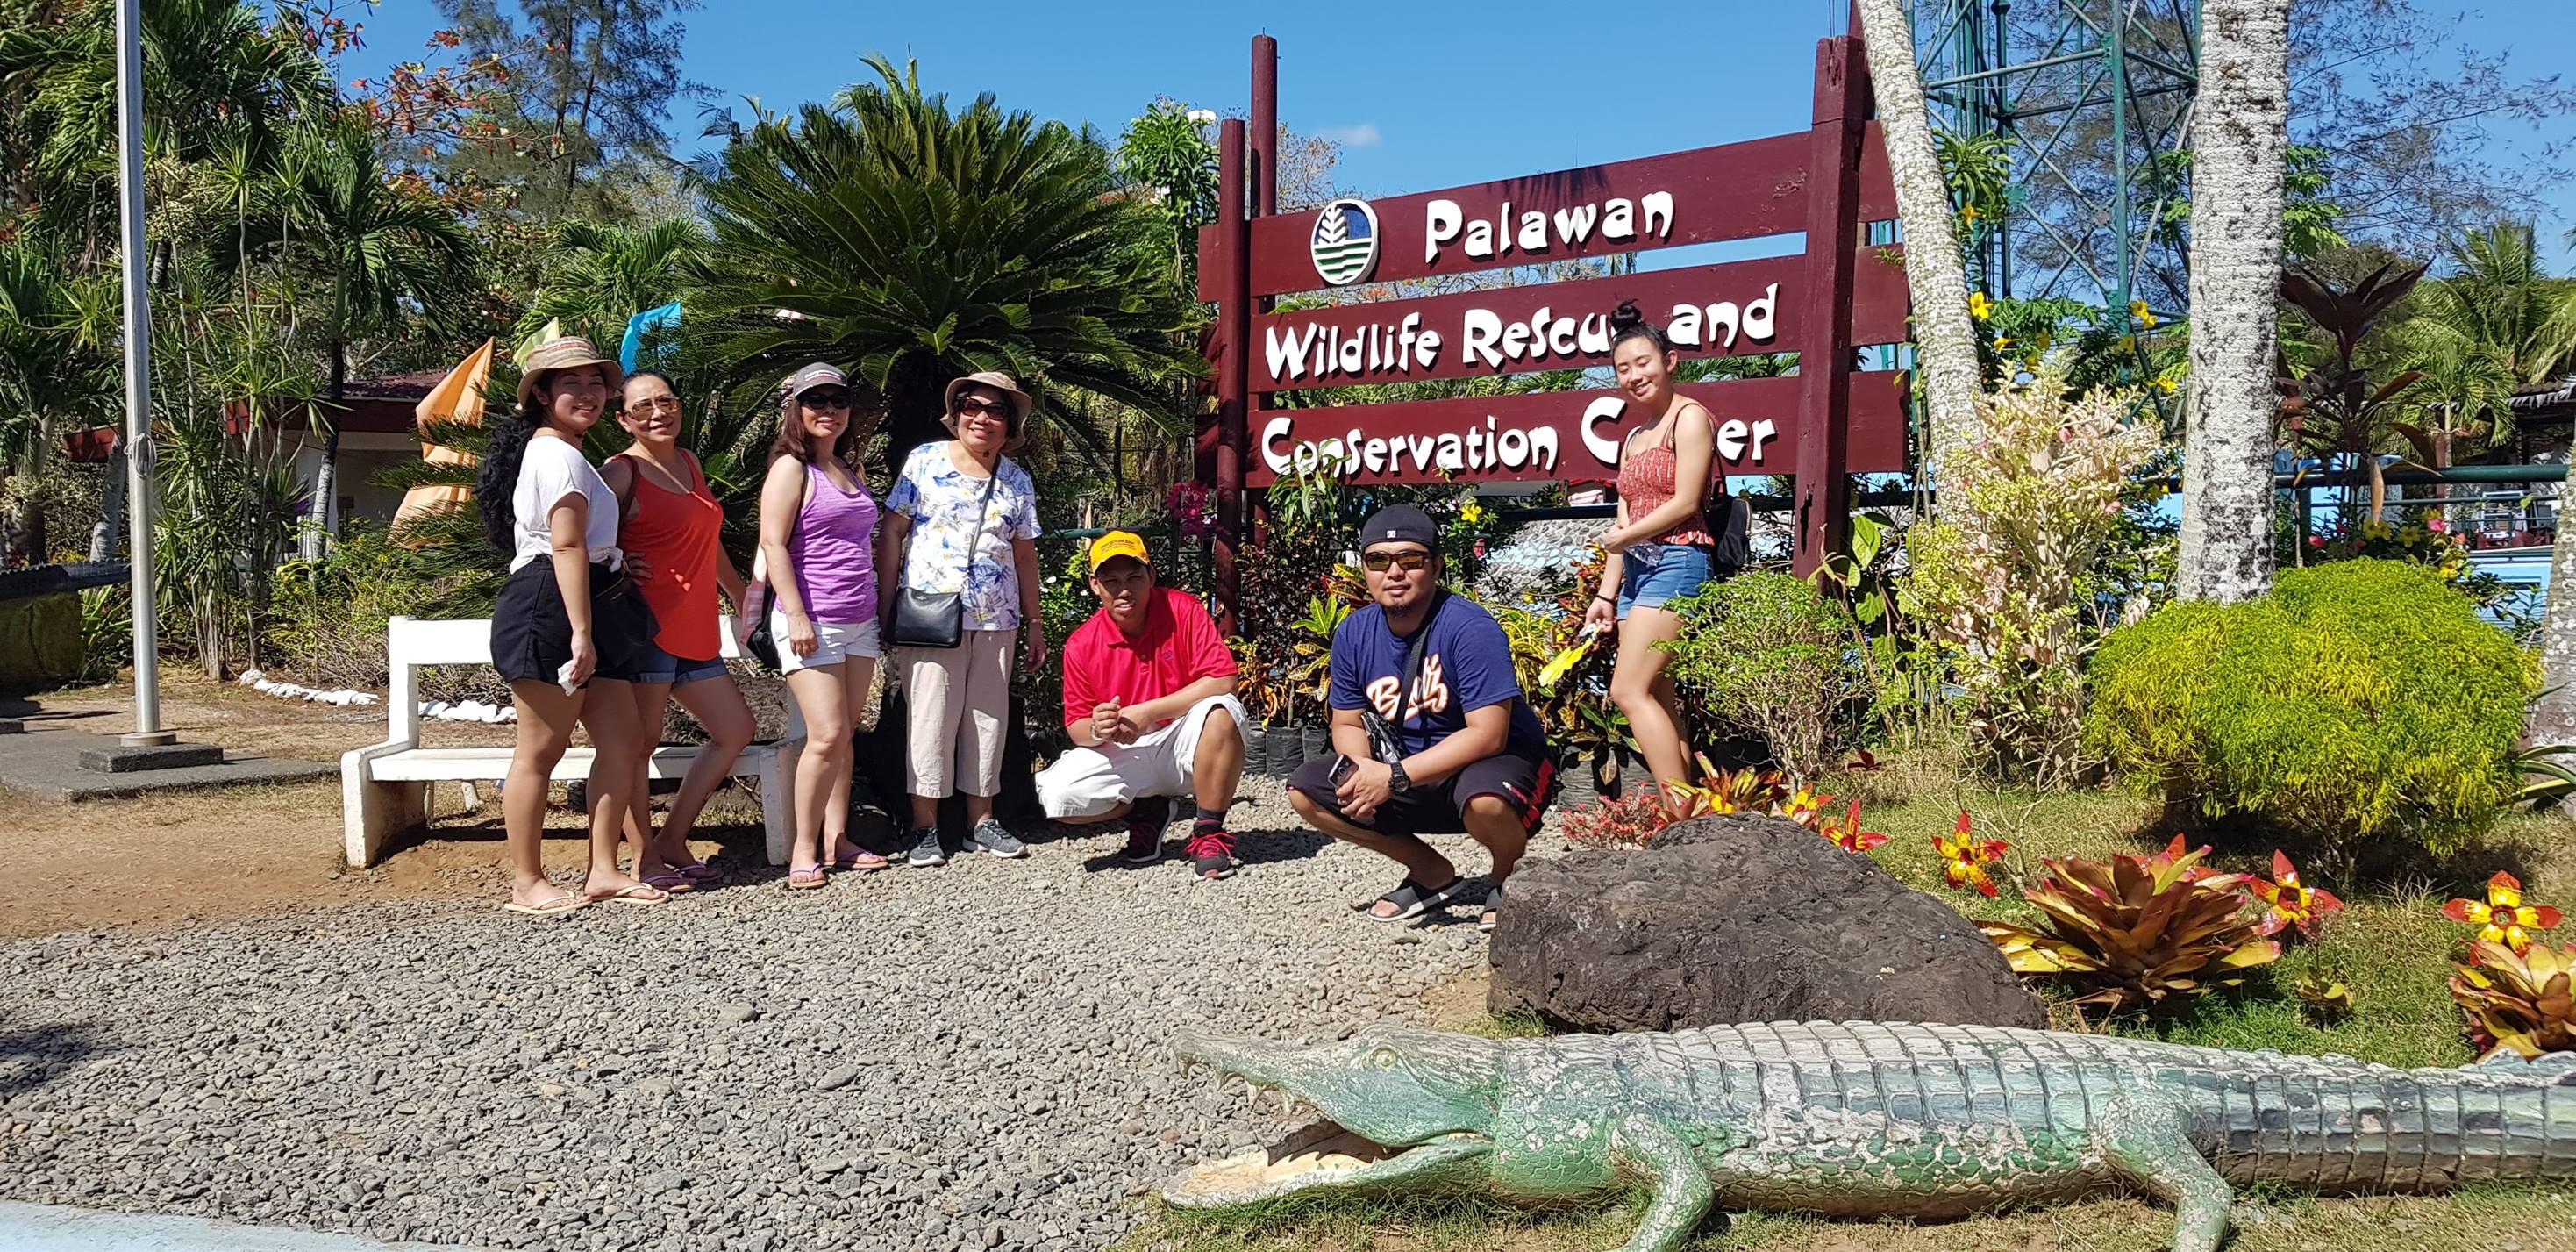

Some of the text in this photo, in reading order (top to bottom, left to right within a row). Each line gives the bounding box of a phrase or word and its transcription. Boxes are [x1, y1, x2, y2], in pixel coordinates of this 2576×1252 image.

[1425, 190, 1673, 263] Palawan
[1265, 283, 1779, 380] Wildlife Rescu and
[1261, 397, 1777, 478] Conservation Cer
